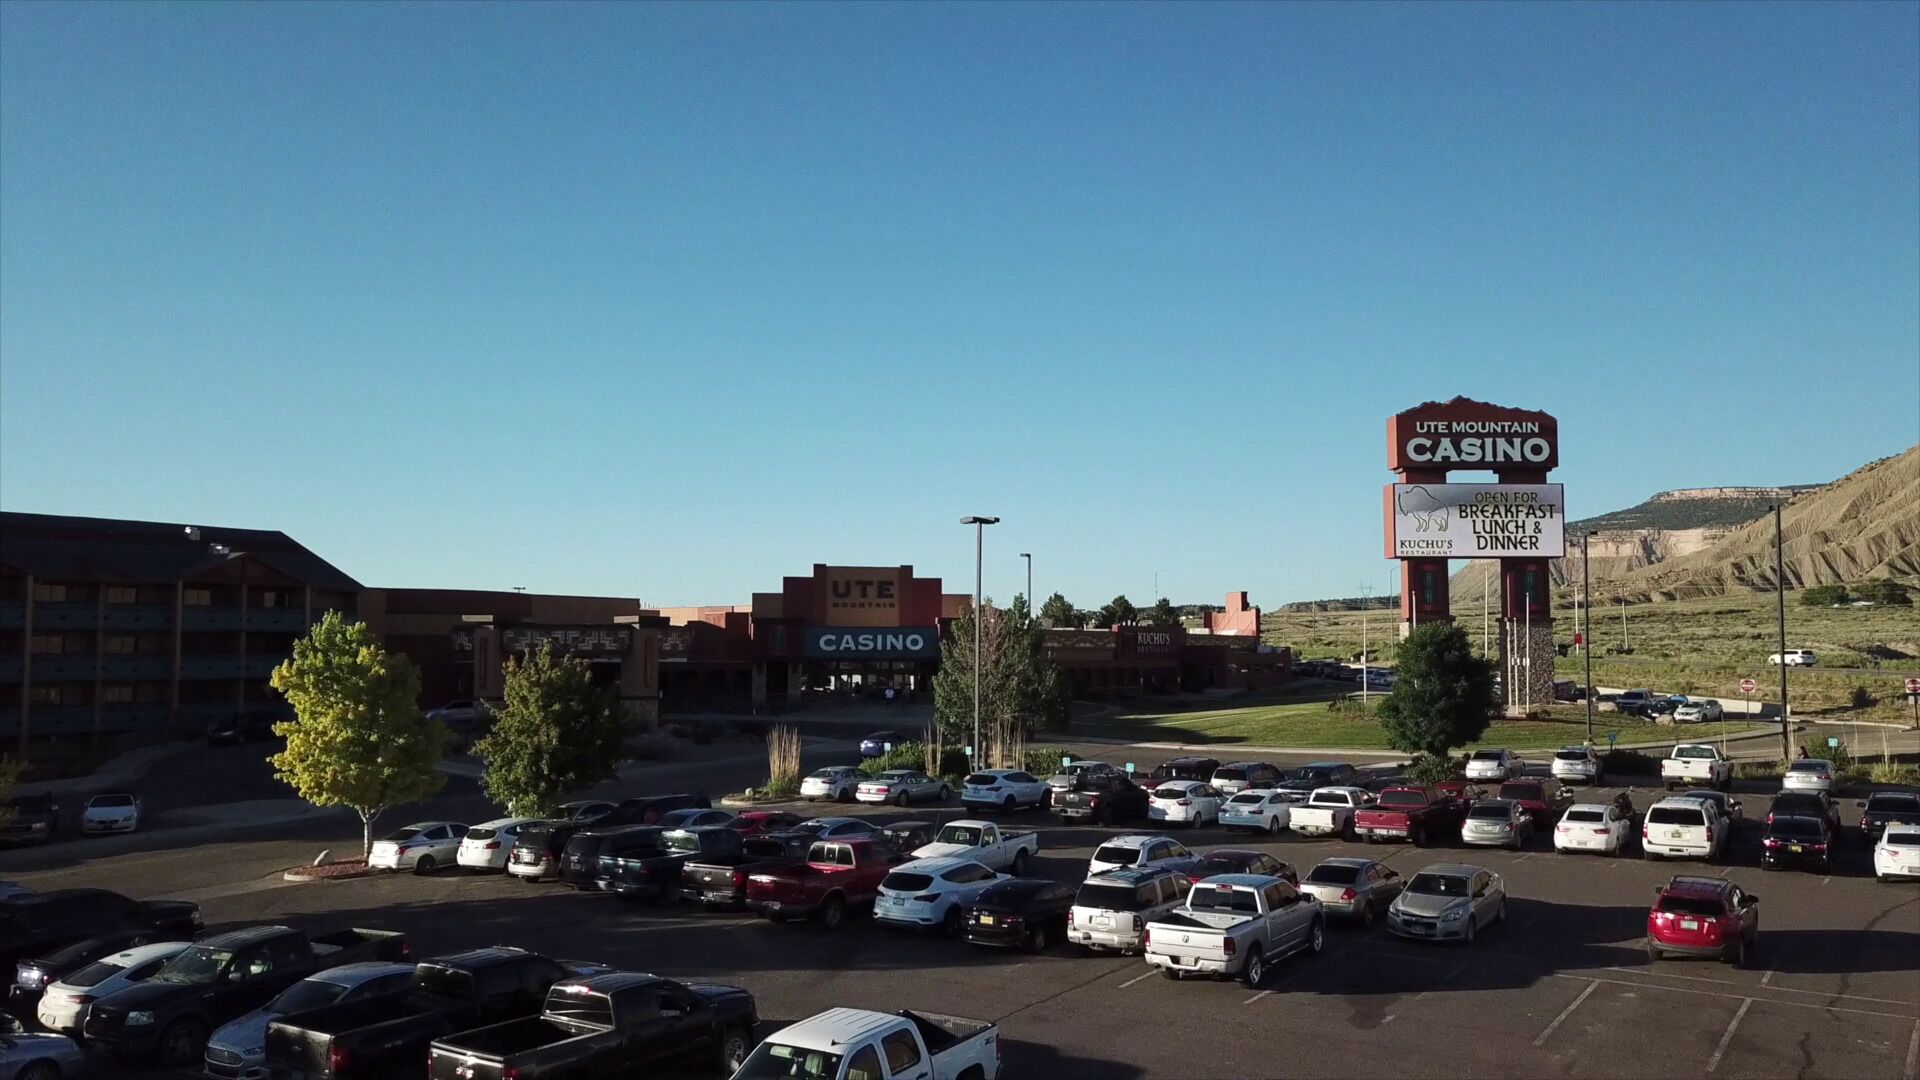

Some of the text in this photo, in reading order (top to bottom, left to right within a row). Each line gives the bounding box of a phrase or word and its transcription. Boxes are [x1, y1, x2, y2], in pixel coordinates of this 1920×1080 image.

[1416, 421, 1539, 433] UTE MOUNTAIN
[1405, 437, 1550, 462] CASINO
[1475, 492, 1538, 503] OPEN FOR
[1459, 504, 1556, 519] BREAKFAST
[1472, 519, 1542, 534] LUNCH &
[1400, 539, 1453, 549] KUCHU'S
[1476, 535, 1539, 550] DINNER
[832, 580, 894, 599] UTE
[819, 634, 924, 651] CASINO
